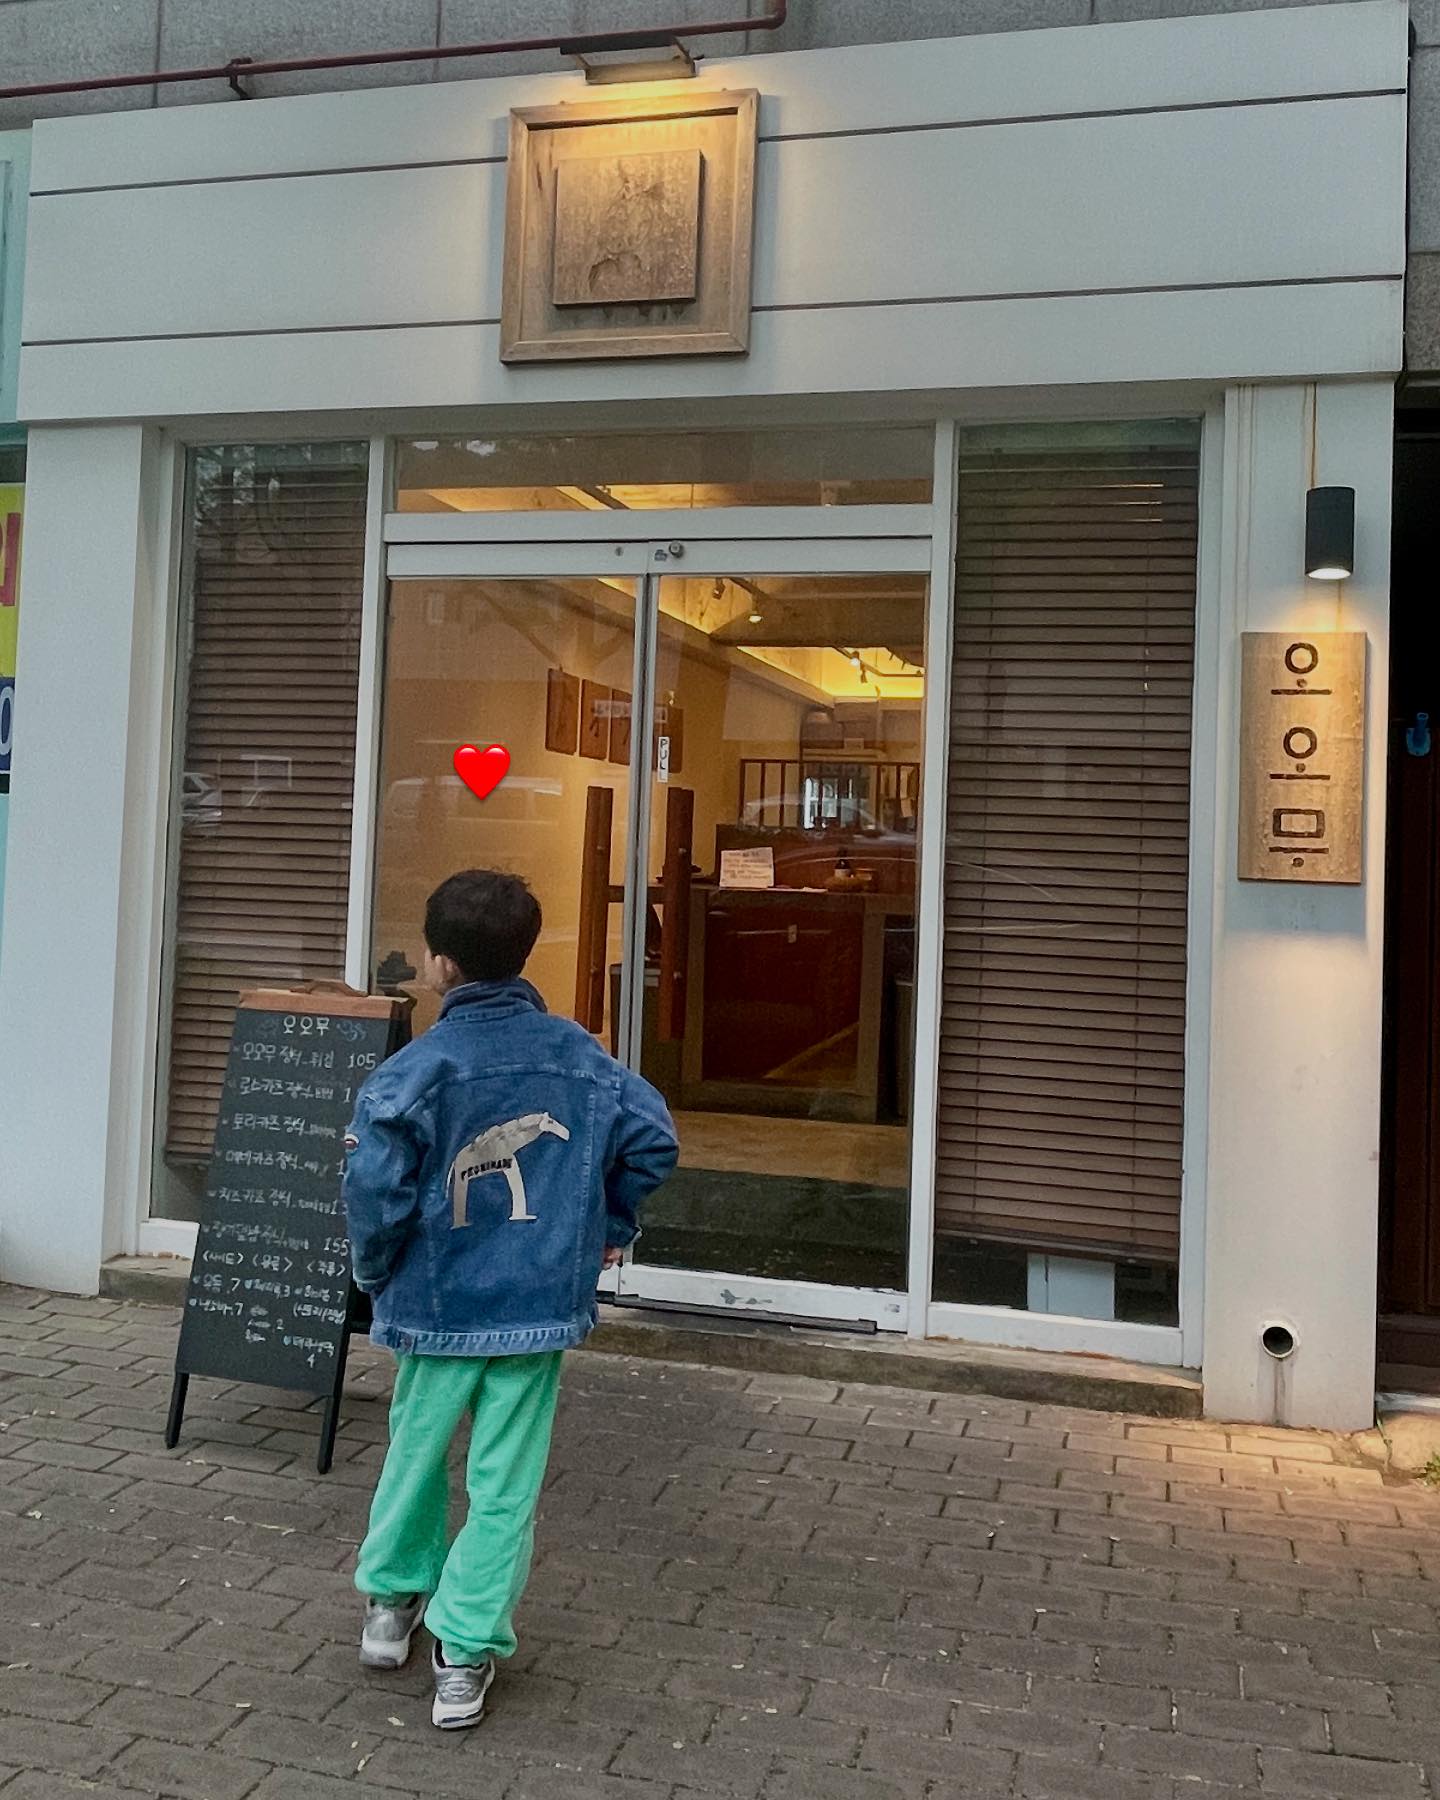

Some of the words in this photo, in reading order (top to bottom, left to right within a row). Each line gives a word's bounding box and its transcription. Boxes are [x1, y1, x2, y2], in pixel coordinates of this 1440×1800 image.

[1268, 642, 1333, 868] 오오무
[283, 1014, 330, 1036] 오오무
[347, 1052, 377, 1071] 105
